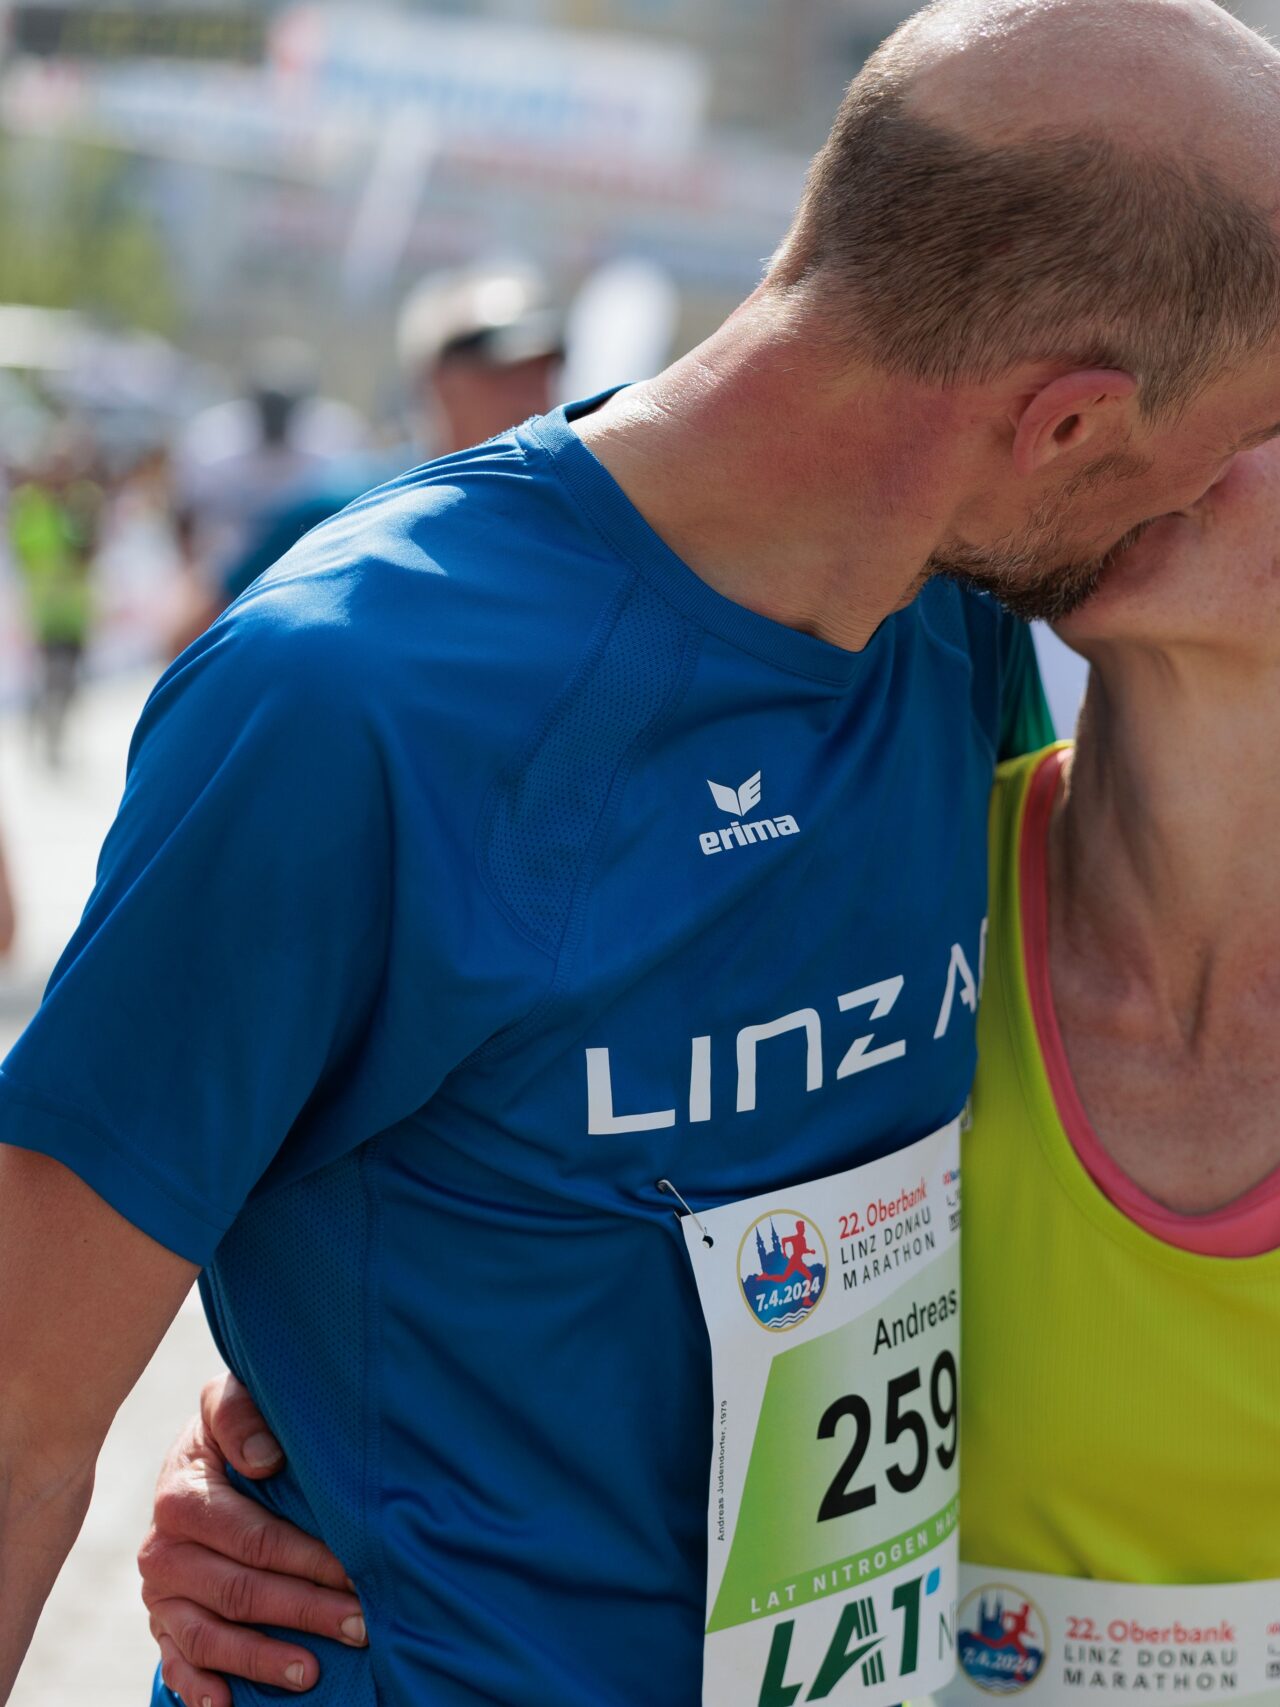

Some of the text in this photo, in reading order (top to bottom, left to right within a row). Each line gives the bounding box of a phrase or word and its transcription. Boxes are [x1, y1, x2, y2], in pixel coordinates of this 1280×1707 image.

[699, 814, 800, 855] erima
[933, 917, 987, 1040] A
[838, 1212, 865, 1240] 22.
[866, 1176, 928, 1226] Oberbank
[840, 1235, 877, 1265] LINZ
[884, 1206, 932, 1246] DONAU
[843, 1231, 936, 1290] MARATHON
[755, 1276, 821, 1313] 7.4.2024
[873, 1289, 958, 1355] Andreas
[816, 1349, 958, 1523] 259
[717, 1498, 725, 1542] Andreas
[751, 1584, 797, 1614] LAT
[813, 1531, 929, 1593] NITROGEN
[757, 1574, 925, 1707] LAT
[1063, 1644, 1239, 1669] LINZ DONAU
[1065, 1616, 1102, 1642] 22.
[1107, 1619, 1237, 1645] Oberbank
[962, 1650, 1037, 1675] 7.4.2024
[1063, 1668, 1238, 1691] MARATHON
